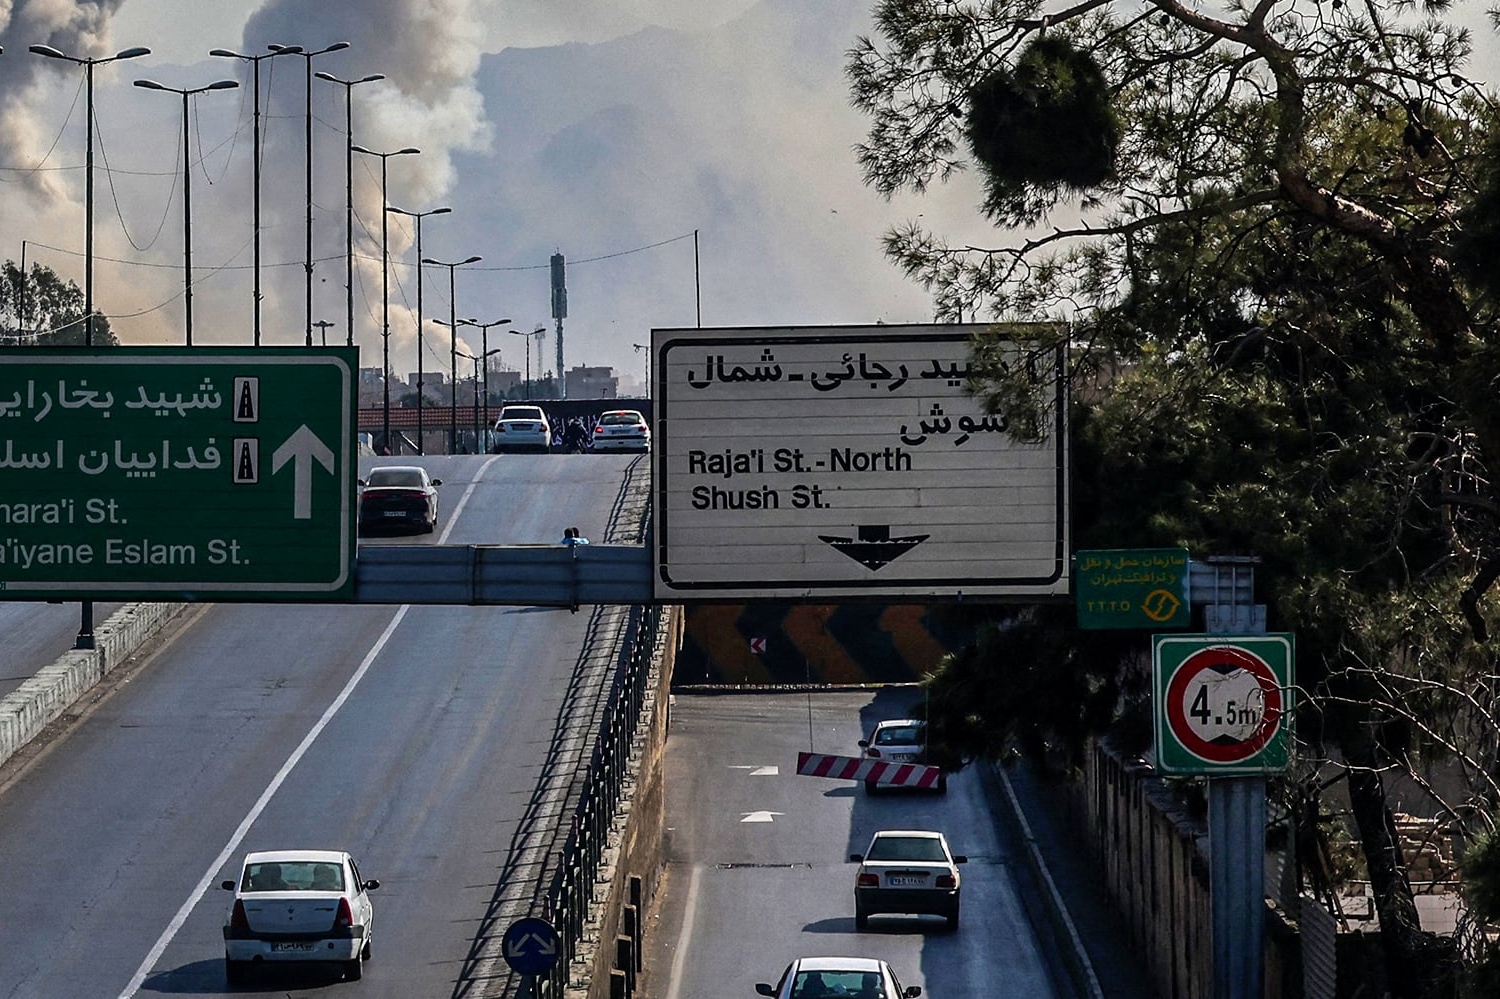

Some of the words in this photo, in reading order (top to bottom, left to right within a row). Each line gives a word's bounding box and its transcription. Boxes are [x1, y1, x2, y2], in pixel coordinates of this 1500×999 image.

[125, 378, 221, 417] شهید
[79, 438, 220, 477] فداییان
[689, 449, 763, 478] Raja'i
[86, 499, 127, 523] St.
[692, 485, 778, 509] Shush
[792, 485, 830, 508] St.
[106, 539, 195, 564] Eslam
[208, 540, 249, 564] St.
[1189, 684, 1257, 726] 4.5m
